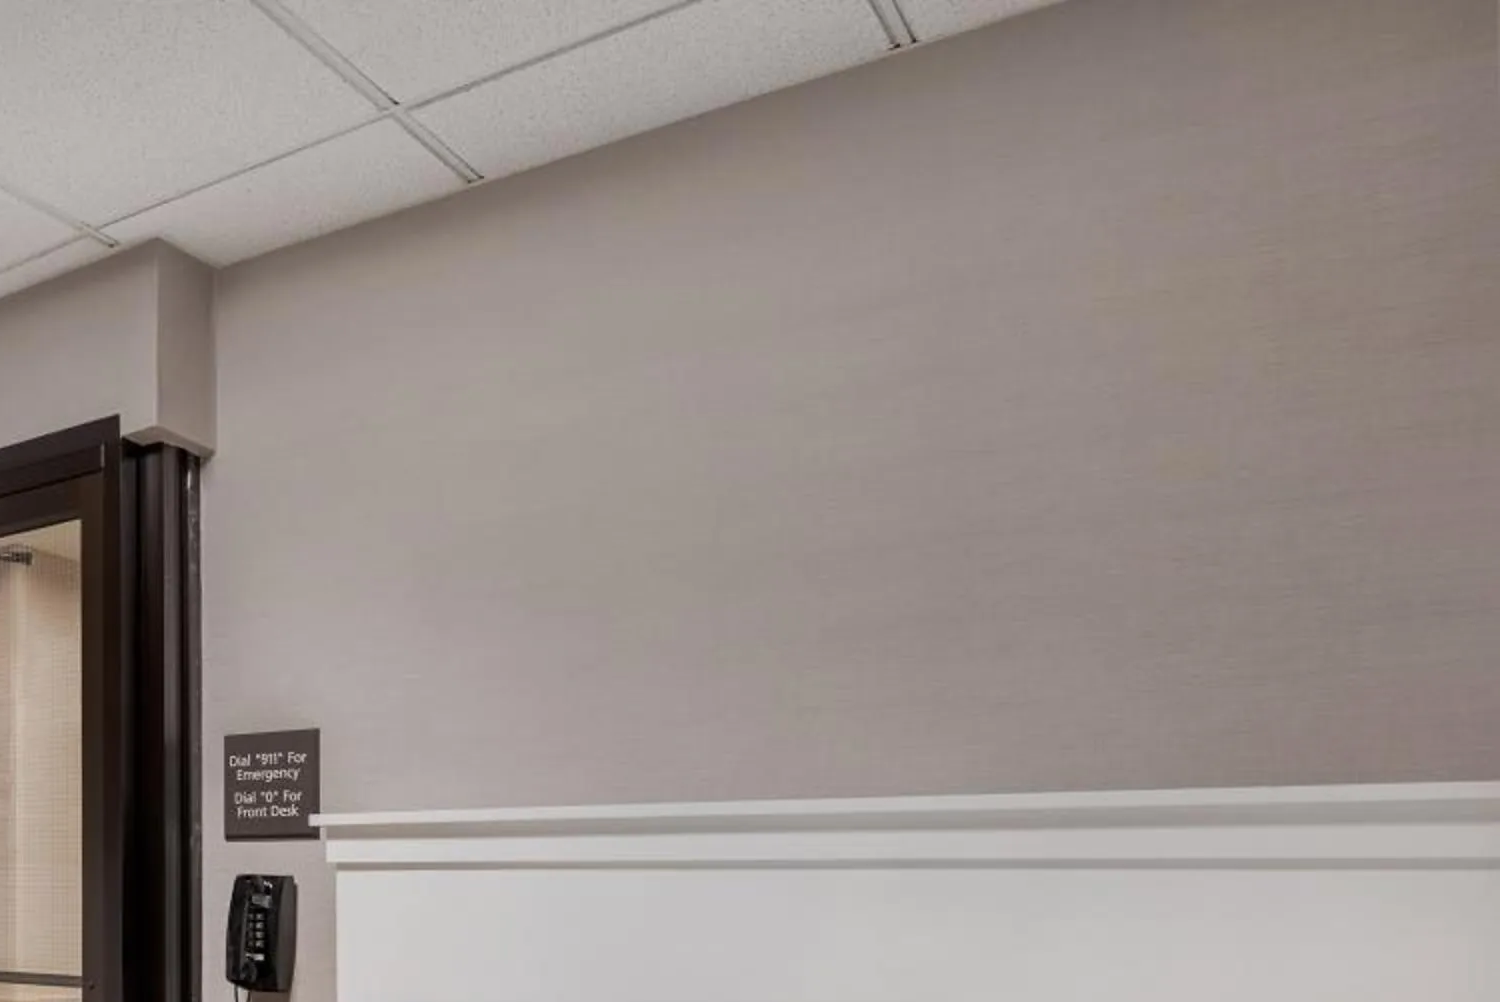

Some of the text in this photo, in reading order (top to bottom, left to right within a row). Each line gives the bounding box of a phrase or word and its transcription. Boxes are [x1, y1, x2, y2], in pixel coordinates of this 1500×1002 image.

[228, 754, 251, 767] Dial
[287, 751, 307, 763] For
[236, 768, 300, 782] Emergency
[233, 791, 257, 804] Dial
[283, 789, 302, 802] For
[236, 804, 299, 818] Front Desk
